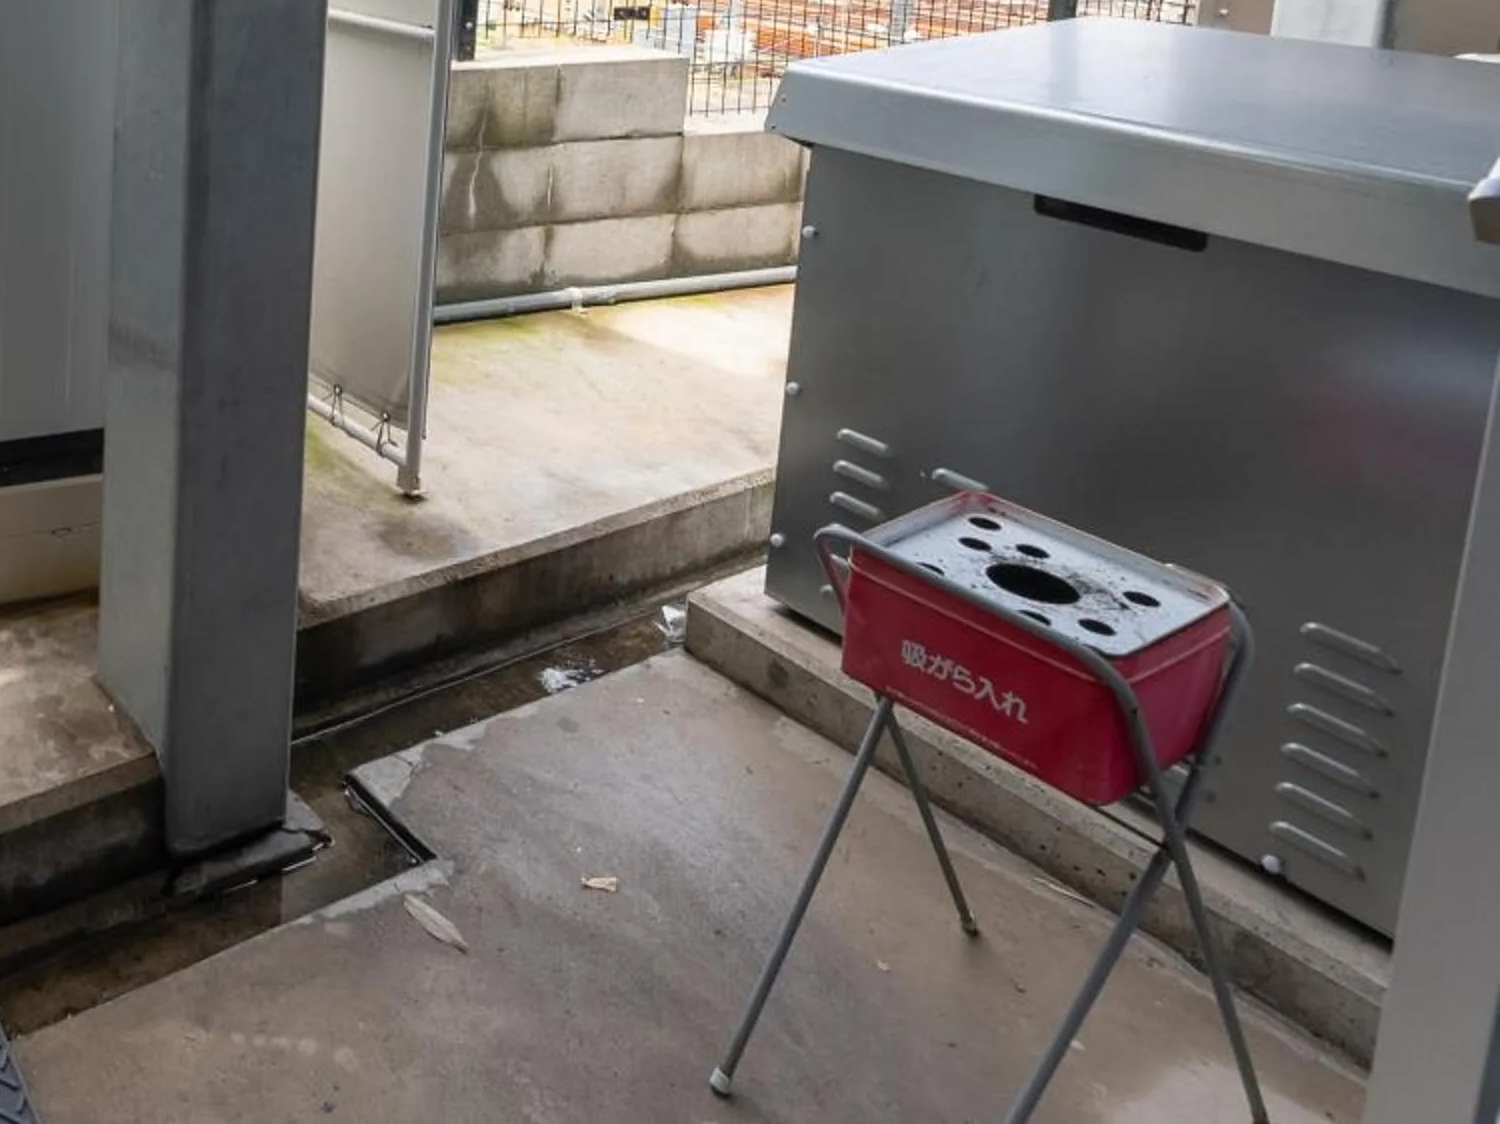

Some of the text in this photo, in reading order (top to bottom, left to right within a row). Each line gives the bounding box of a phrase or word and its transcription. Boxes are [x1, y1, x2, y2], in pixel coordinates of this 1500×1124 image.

[901, 639, 1028, 724] 吸がら入れ
